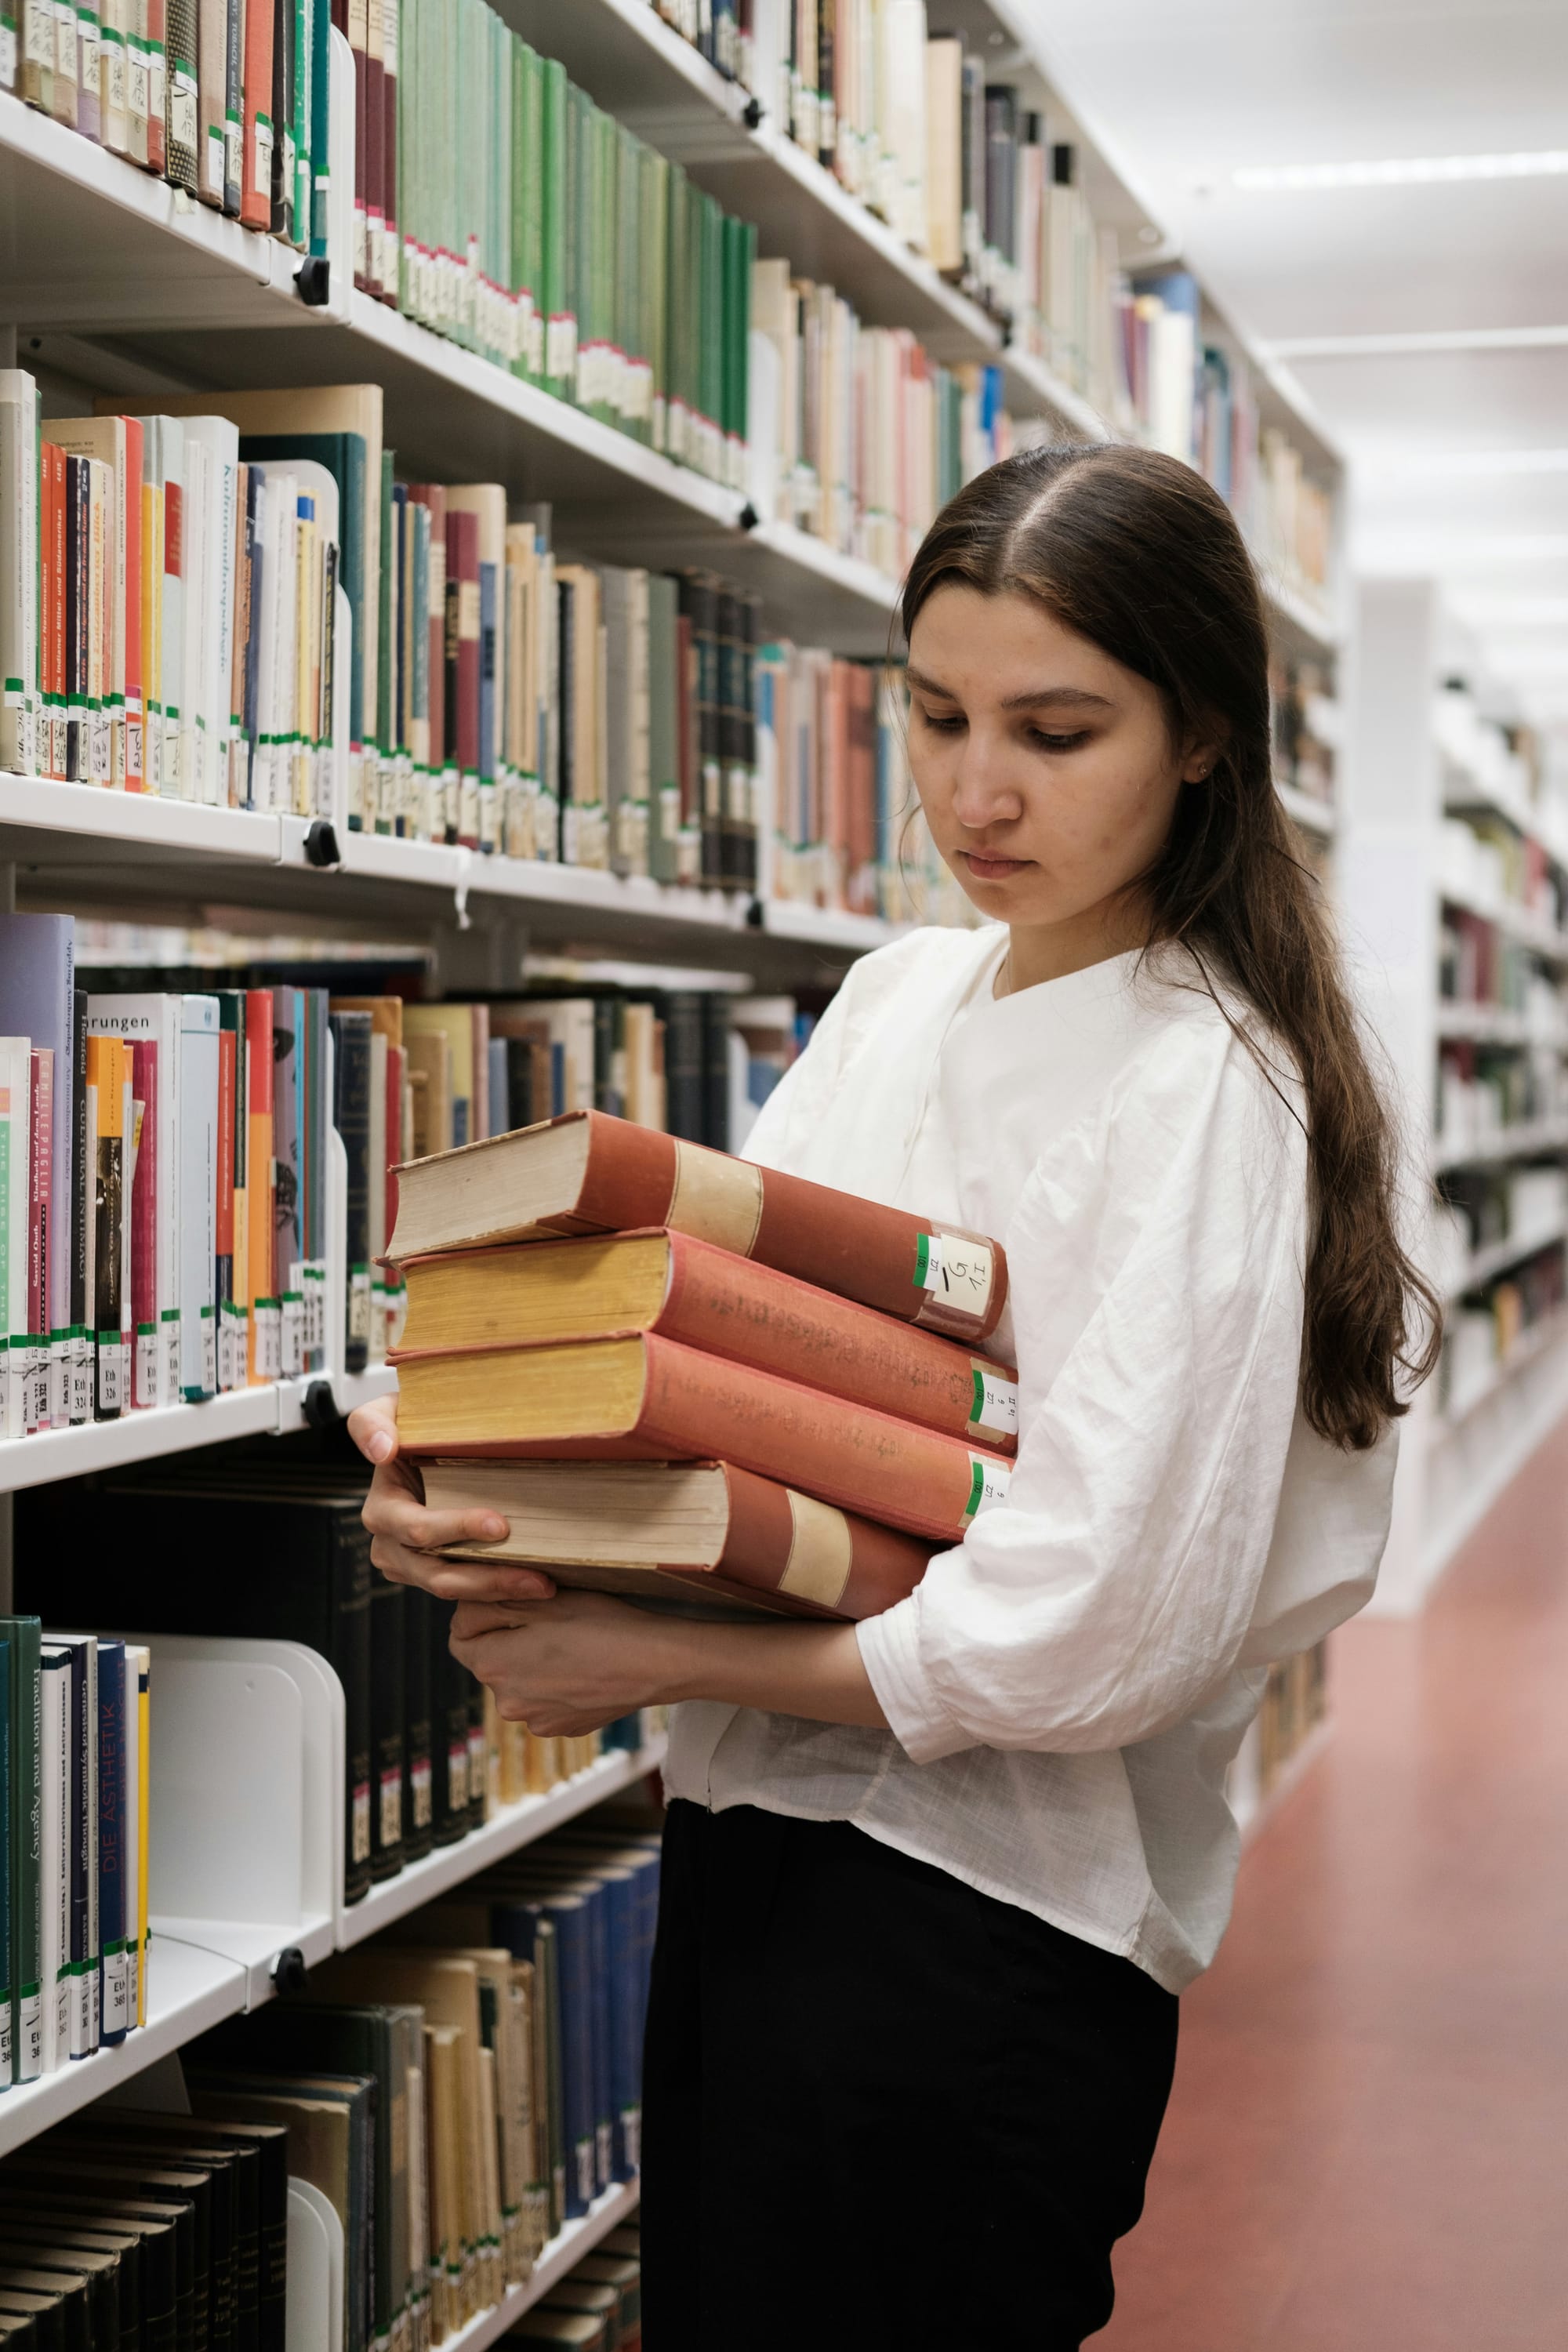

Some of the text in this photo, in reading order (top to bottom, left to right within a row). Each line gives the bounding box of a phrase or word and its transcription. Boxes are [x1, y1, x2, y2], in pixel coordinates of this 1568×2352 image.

[65, 1065, 71, 1080] An
[947, 1261, 970, 1278] G
[104, 1369, 116, 1383] Eth
[105, 1387, 116, 1401] 326
[986, 1391, 995, 1405] LCZ
[985, 1484, 994, 1498] LCZ
[82, 1733, 88, 1747] of
[100, 1701, 117, 1873] DIE ÄSTHETIK
[30, 1794, 41, 1862] Agency
[1, 2034, 11, 2048] Et
[31, 2031, 41, 2044] Et
[2, 2049, 12, 2063] 36
